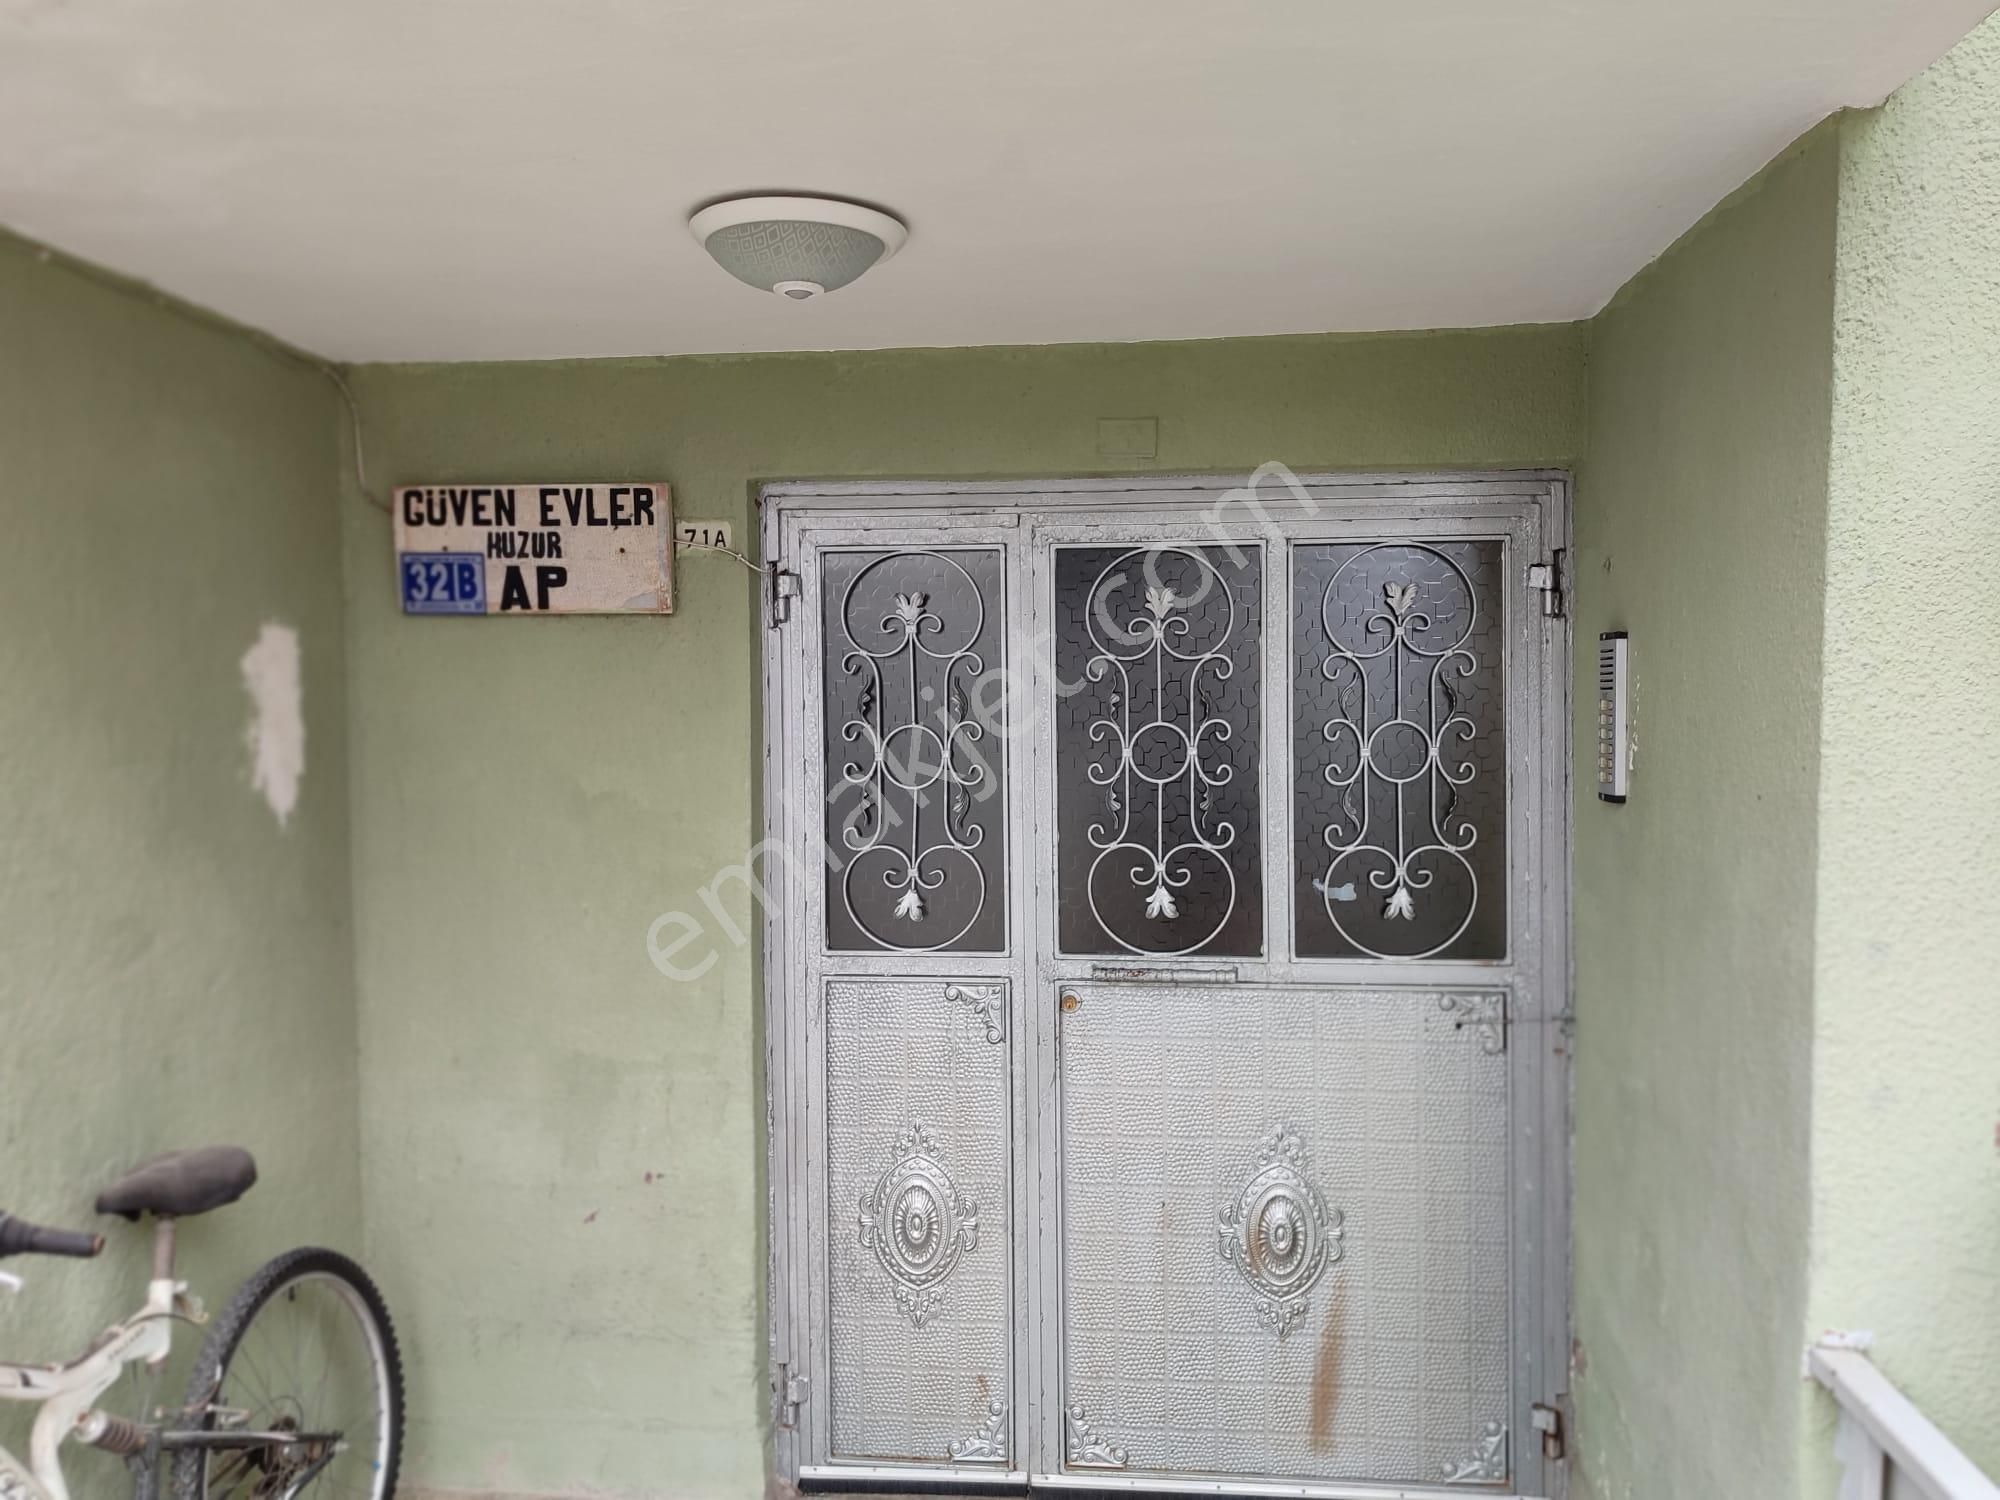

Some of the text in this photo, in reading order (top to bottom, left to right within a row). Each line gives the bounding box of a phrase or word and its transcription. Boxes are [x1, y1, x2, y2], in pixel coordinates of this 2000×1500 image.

[403, 486, 654, 527] GÜVEN EVLER
[487, 531, 562, 559] HUZUR
[685, 528, 726, 548] 71A
[500, 565, 567, 611] AP
